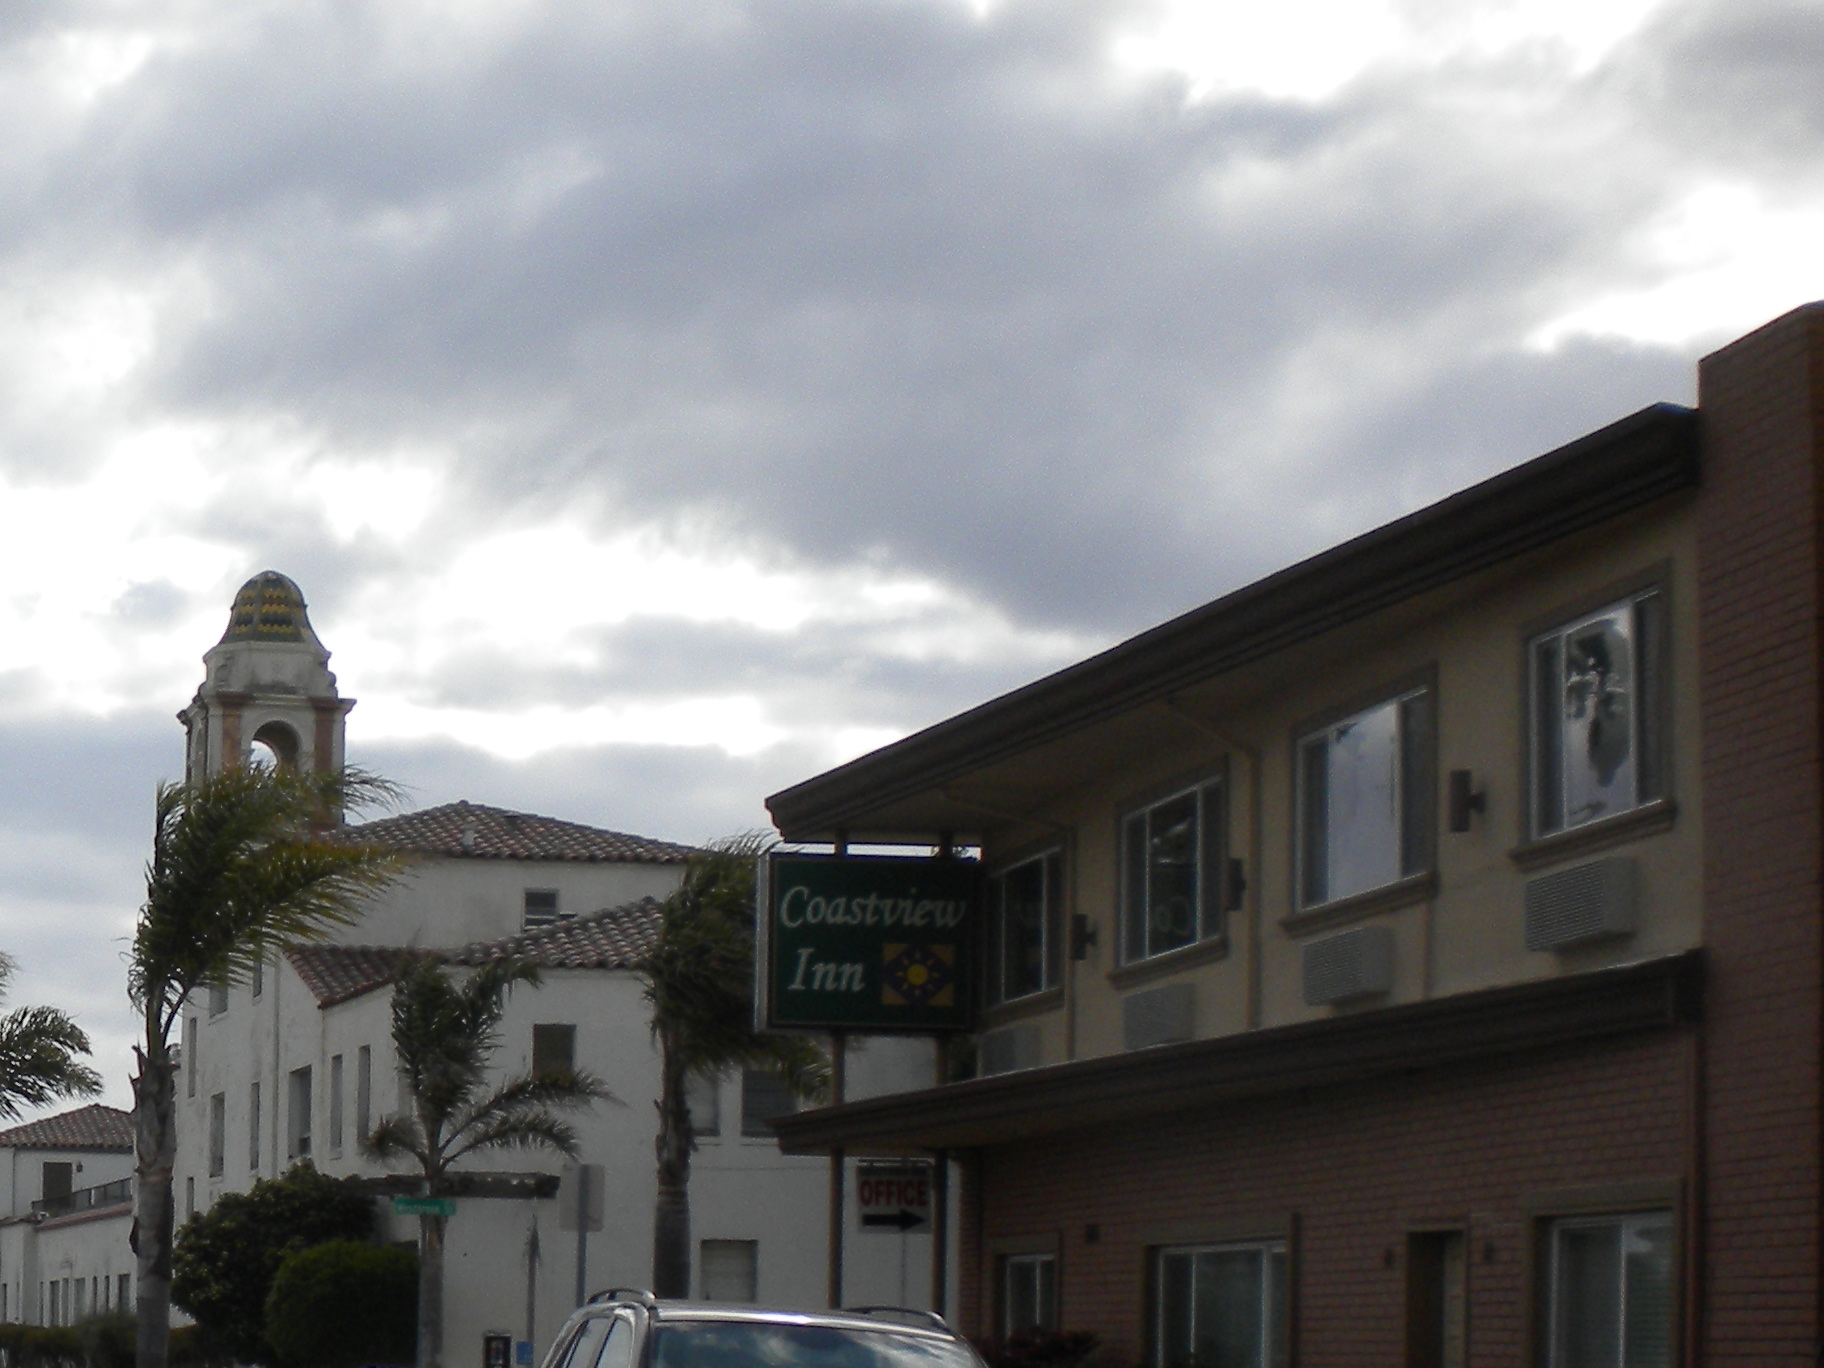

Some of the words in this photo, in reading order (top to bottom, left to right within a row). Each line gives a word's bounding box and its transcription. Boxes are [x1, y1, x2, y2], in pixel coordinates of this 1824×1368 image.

[780, 885, 966, 929] Coastview
[788, 947, 866, 992] Inn
[859, 1179, 928, 1206] OFFICE
